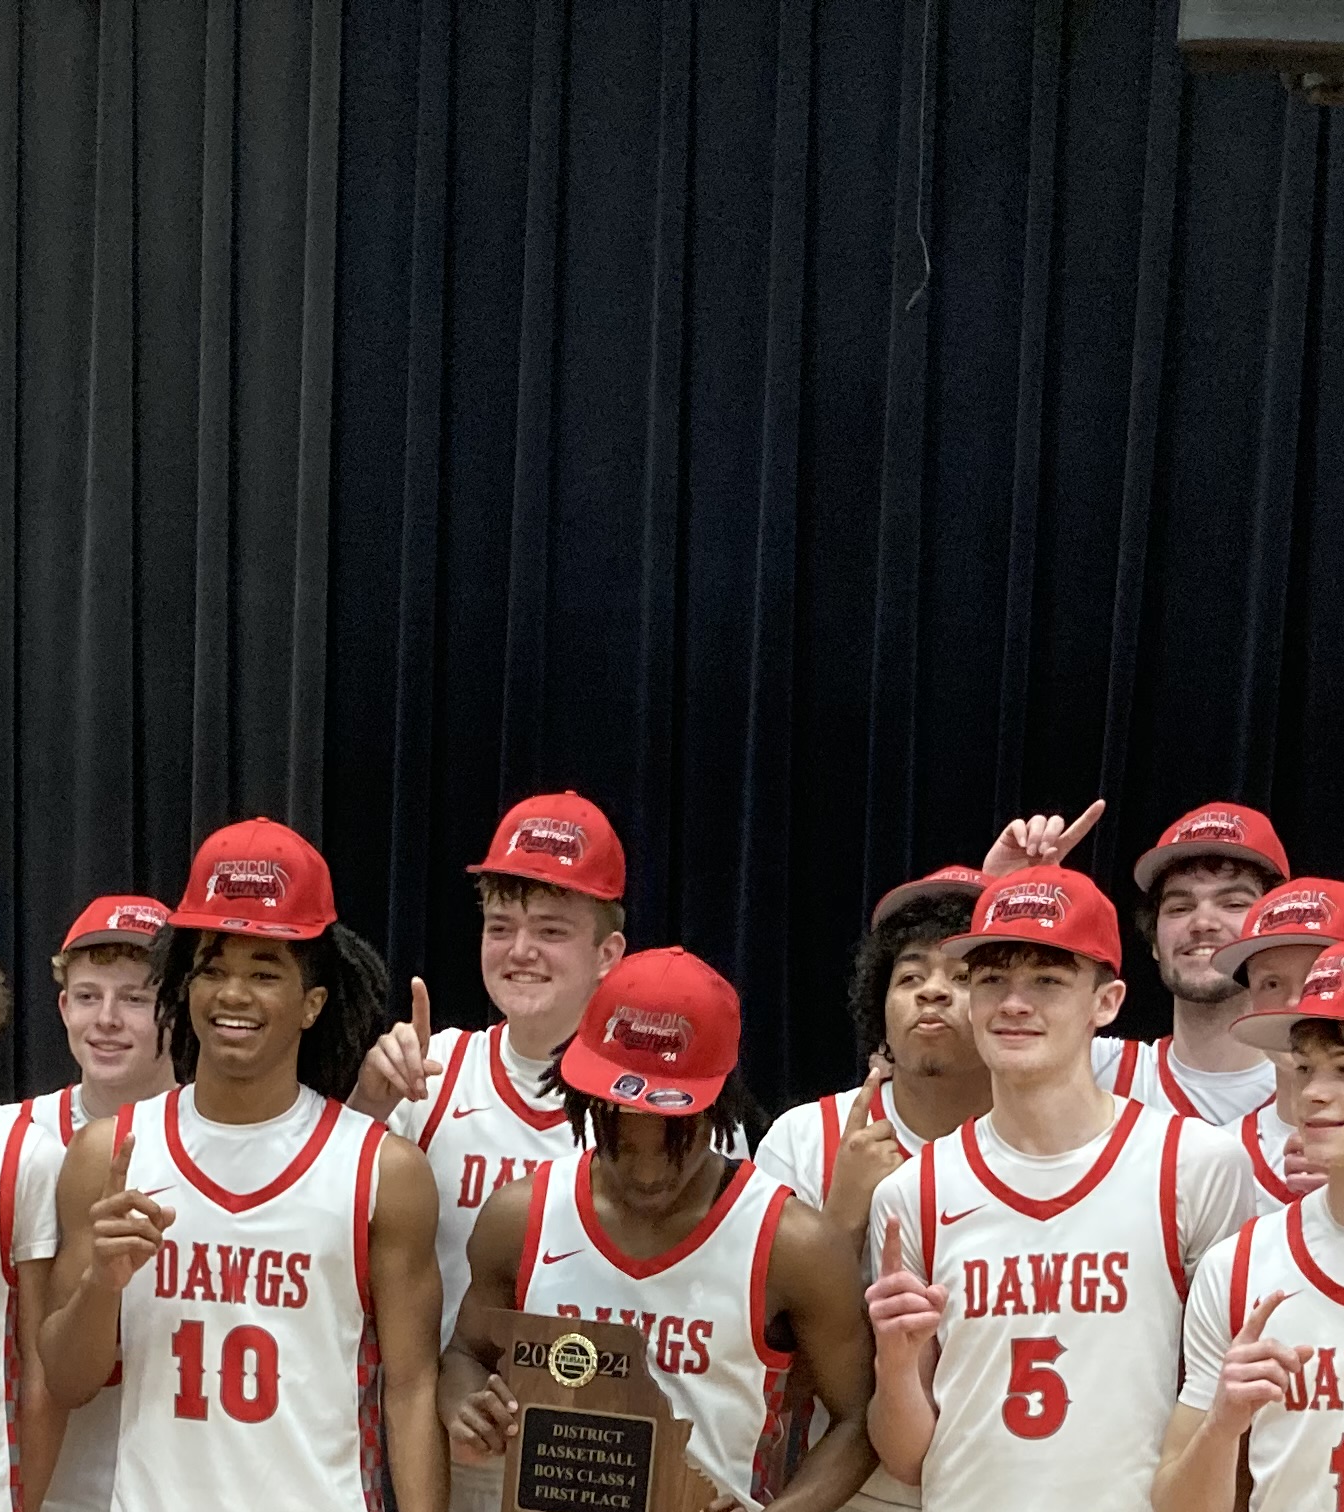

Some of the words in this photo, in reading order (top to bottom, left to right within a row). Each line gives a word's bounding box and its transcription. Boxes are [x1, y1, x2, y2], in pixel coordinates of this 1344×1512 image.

[230, 873, 274, 883] DISTRICT
[1008, 894, 1056, 905] DISTRICT
[155, 1240, 311, 1309] DAWGS
[963, 1252, 1129, 1320] DAWGS
[171, 1319, 281, 1424] 10
[1002, 1335, 1073, 1441] 5
[553, 1424, 625, 1445] DISTRICT
[537, 1443, 636, 1467] BASKETBALL
[534, 1464, 574, 1480] BOYS
[576, 1469, 626, 1487] CLASS
[627, 1475, 636, 1489] 4
[535, 1485, 579, 1502] FIRST
[581, 1490, 631, 1509] PLACE
